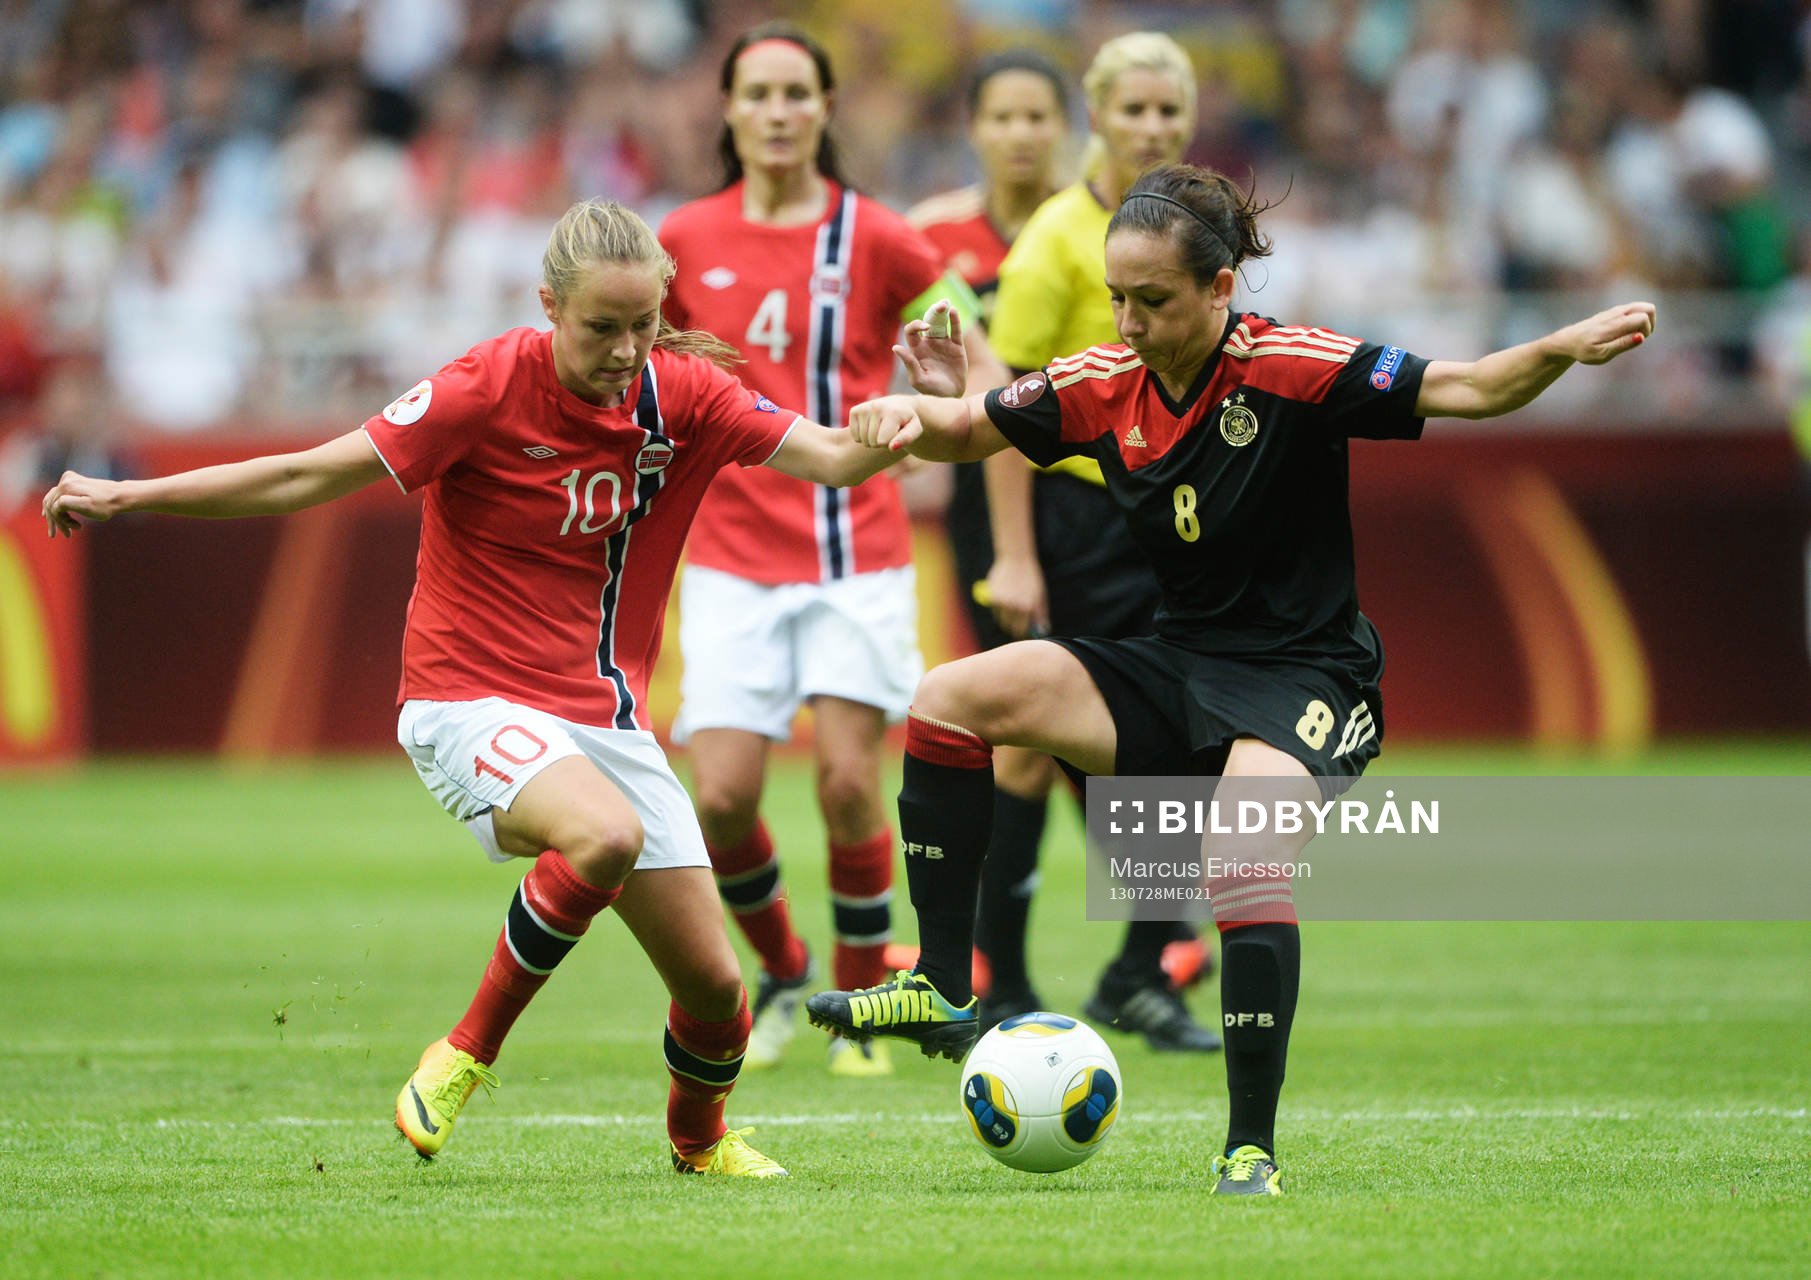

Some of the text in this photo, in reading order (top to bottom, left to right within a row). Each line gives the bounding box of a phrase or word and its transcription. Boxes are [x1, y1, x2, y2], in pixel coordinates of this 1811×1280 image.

[745, 289, 792, 364] 4
[1124, 438, 1148, 448] adidas
[559, 469, 622, 536] 10
[1173, 484, 1200, 543] 8
[1295, 699, 1335, 751] 8
[474, 724, 548, 785] 10
[848, 989, 941, 1029] PUMA
[1224, 1012, 1275, 1028] DFB
